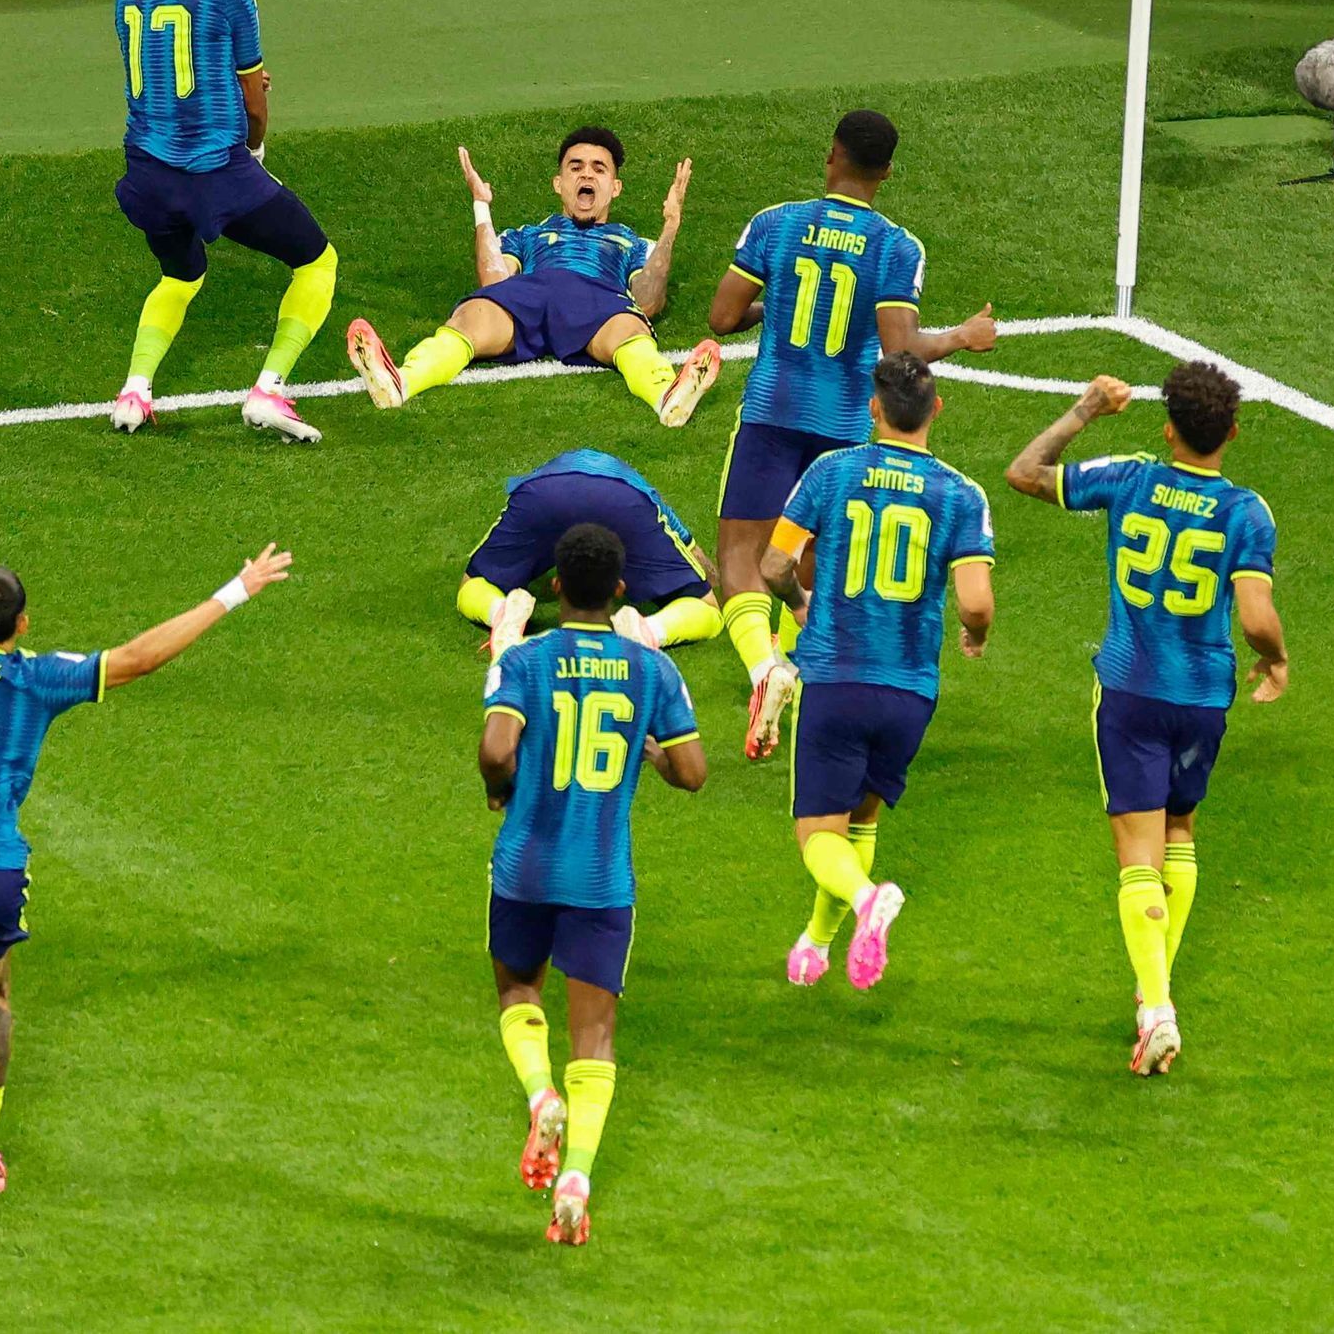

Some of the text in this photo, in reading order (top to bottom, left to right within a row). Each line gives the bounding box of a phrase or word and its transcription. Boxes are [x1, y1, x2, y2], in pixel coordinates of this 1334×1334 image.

[124, 4, 196, 100] 17
[802, 224, 867, 256] J.ARIAS
[790, 257, 857, 357] 11
[862, 467, 925, 494] JAMES
[1151, 483, 1218, 519] SUAREZ
[843, 499, 932, 603] 10
[1116, 511, 1227, 617] 25
[555, 656, 629, 680] J.LERMA
[552, 690, 635, 792] 16
